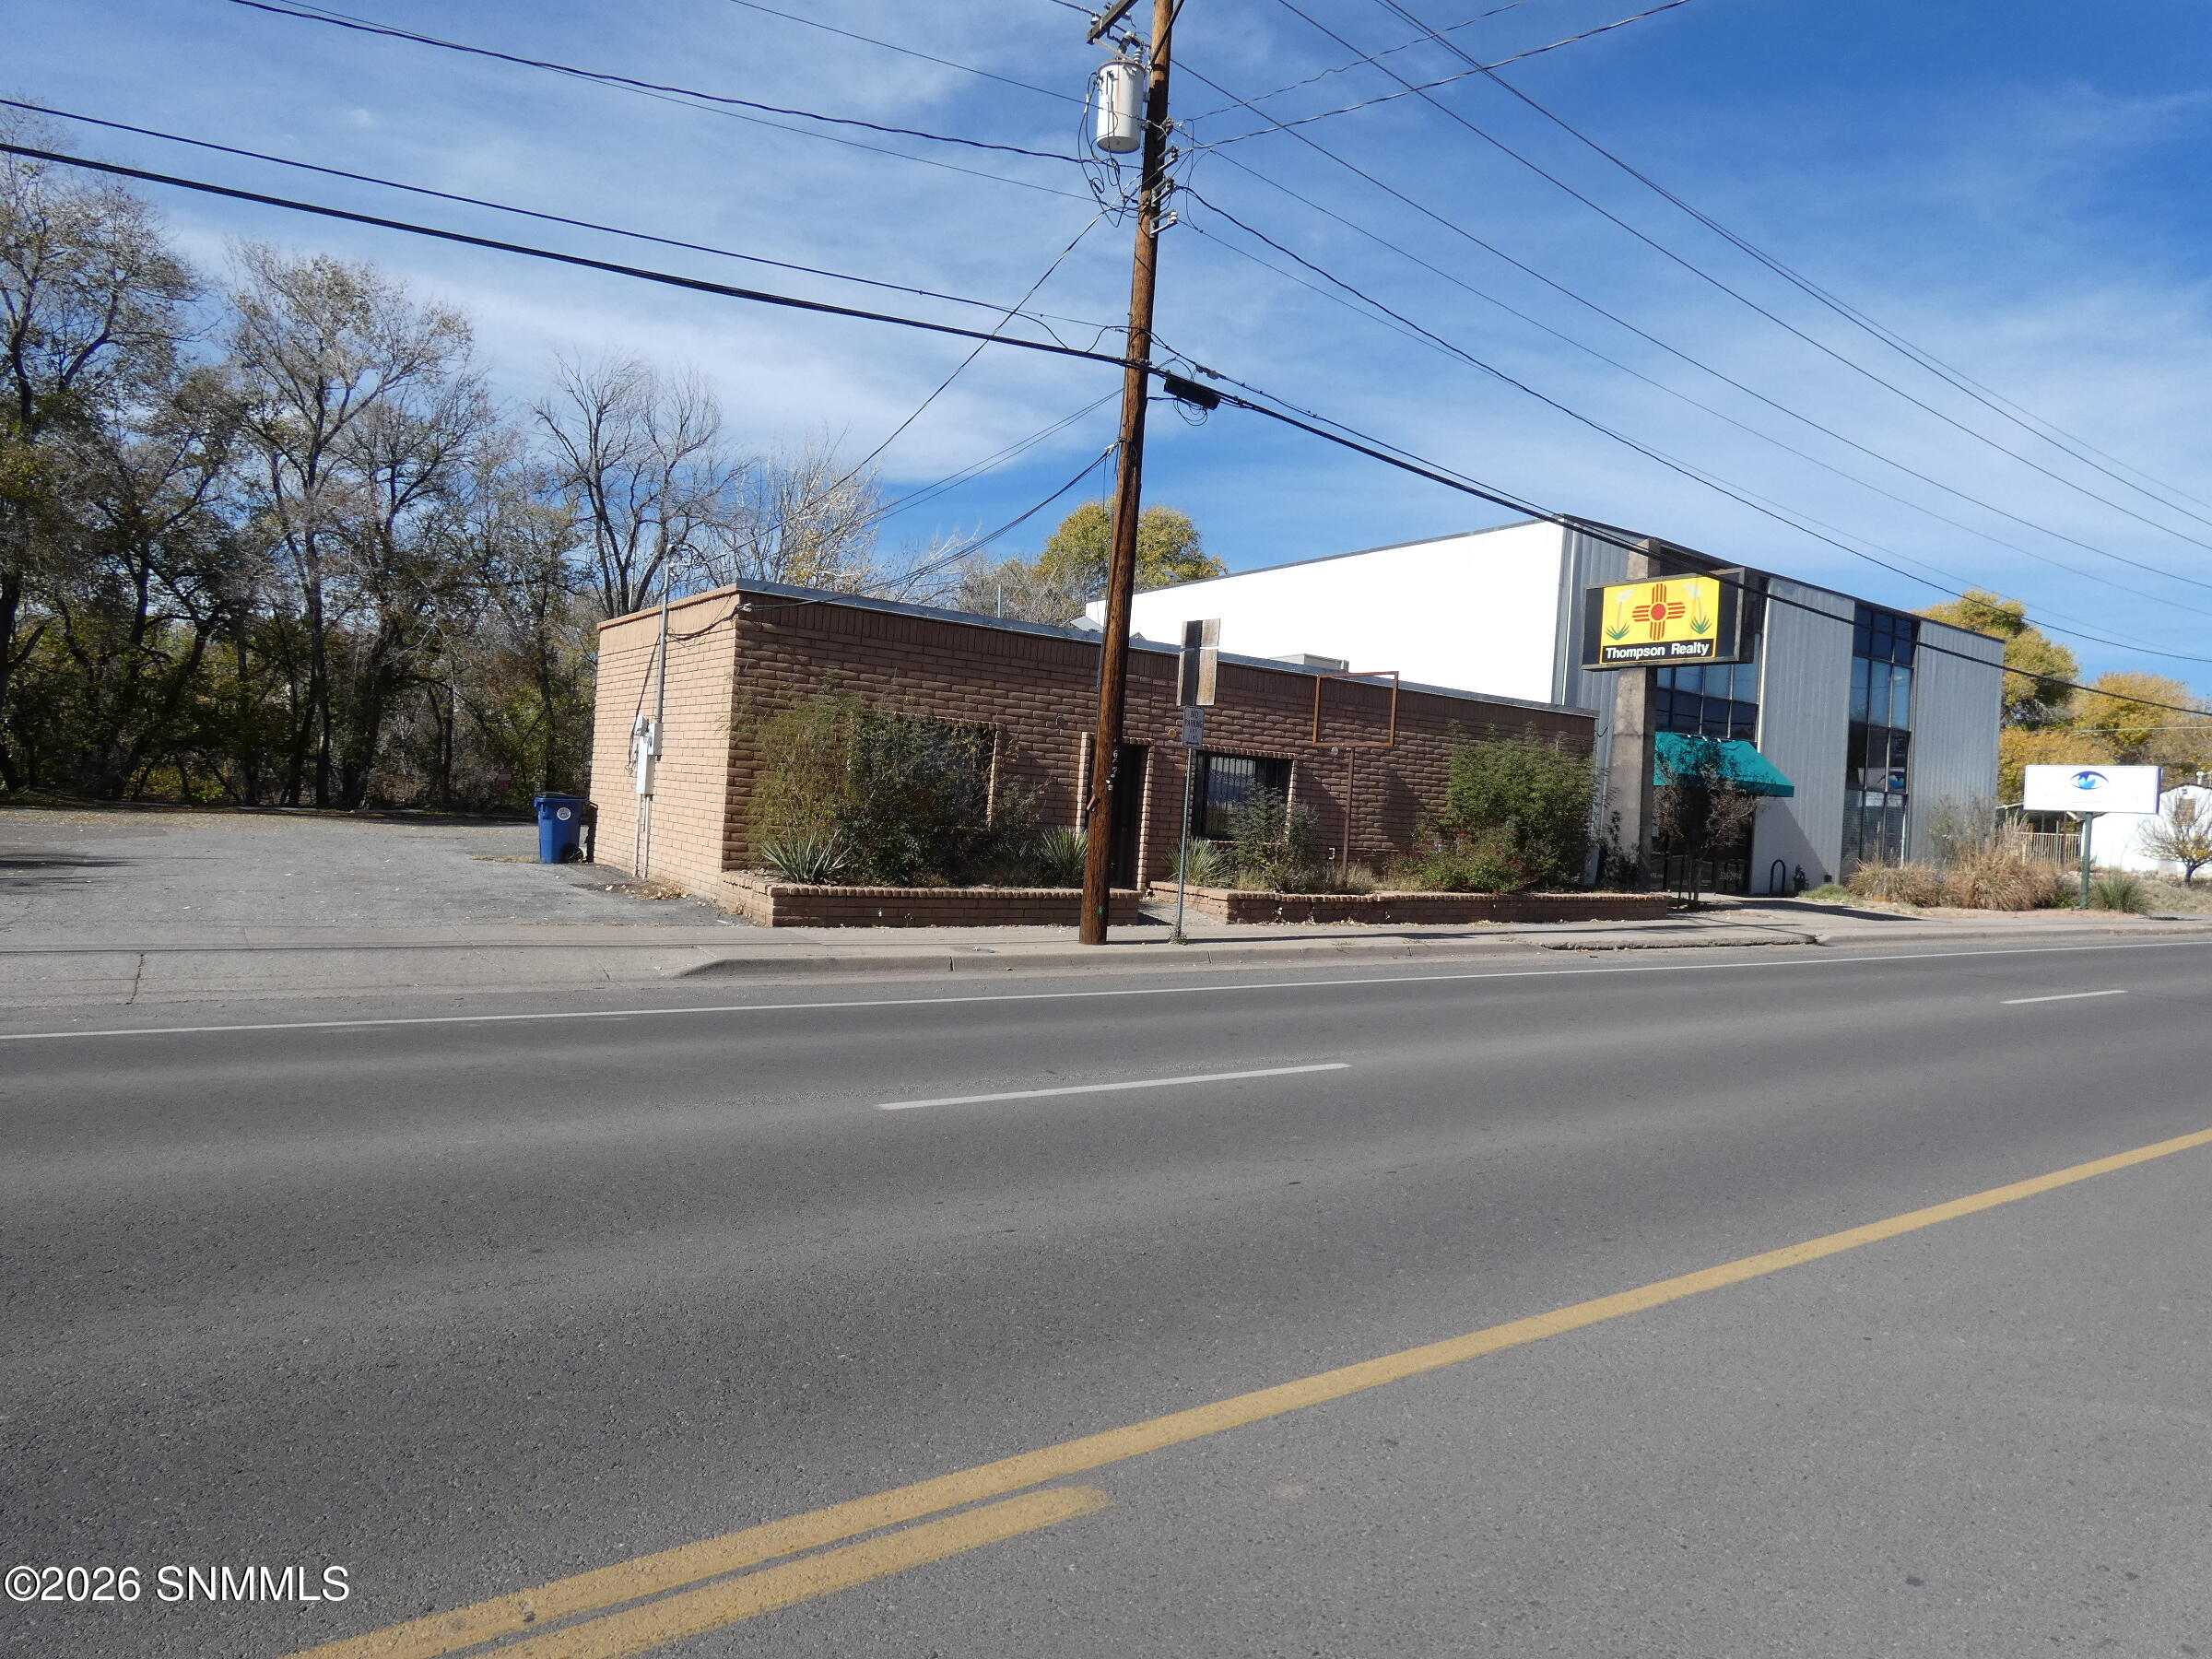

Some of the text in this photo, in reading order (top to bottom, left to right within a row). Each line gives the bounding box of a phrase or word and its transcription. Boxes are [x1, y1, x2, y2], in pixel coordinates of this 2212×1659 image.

[1606, 642, 1710, 660] Thompson Realty
[1191, 710, 1199, 718] NO
[1185, 719, 1203, 728] PARKING
